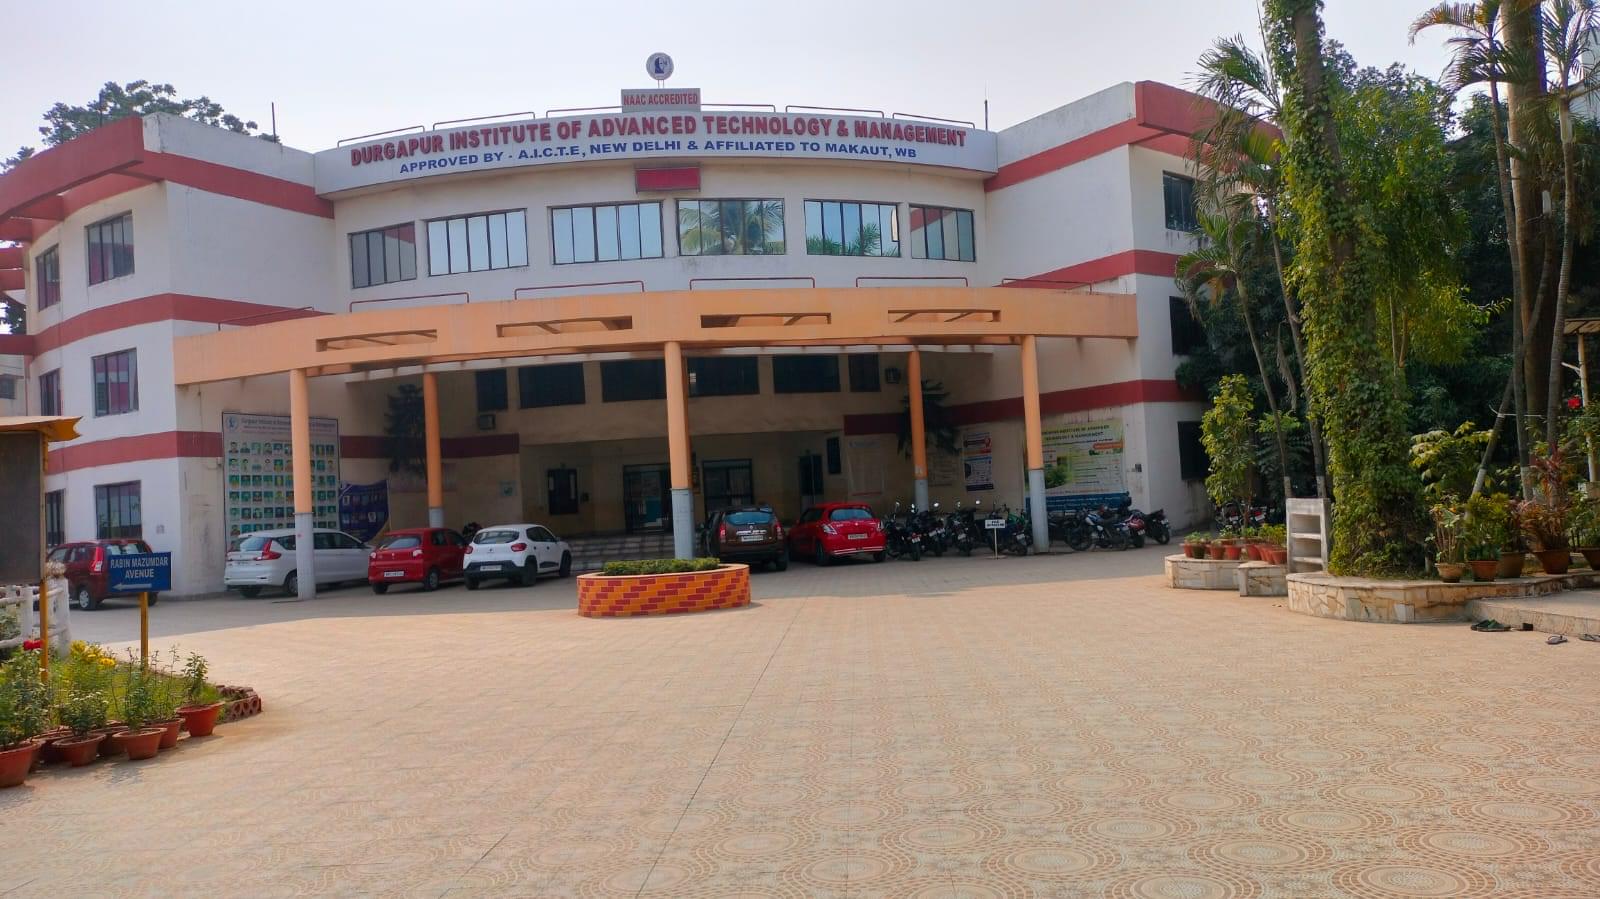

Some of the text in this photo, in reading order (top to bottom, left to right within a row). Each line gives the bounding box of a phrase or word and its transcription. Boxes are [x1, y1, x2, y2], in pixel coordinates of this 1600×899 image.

[623, 93, 698, 105] NAAC ACCREDITED
[351, 115, 967, 166] DURGAPUR INSTITUTE OF ADVANCED TECHNOLOGY & MANAGEMENT
[400, 155, 478, 173] APPROVED
[483, 151, 504, 162] BY
[590, 142, 628, 155] NEW
[632, 140, 681, 152] DELHI
[687, 140, 699, 150] &
[704, 141, 796, 152] AFFILIATED
[800, 142, 820, 153] TO
[895, 147, 917, 158] WB
[110, 557, 168, 568] RABIN MAZUMDAR
[125, 569, 154, 578] AVENUE
